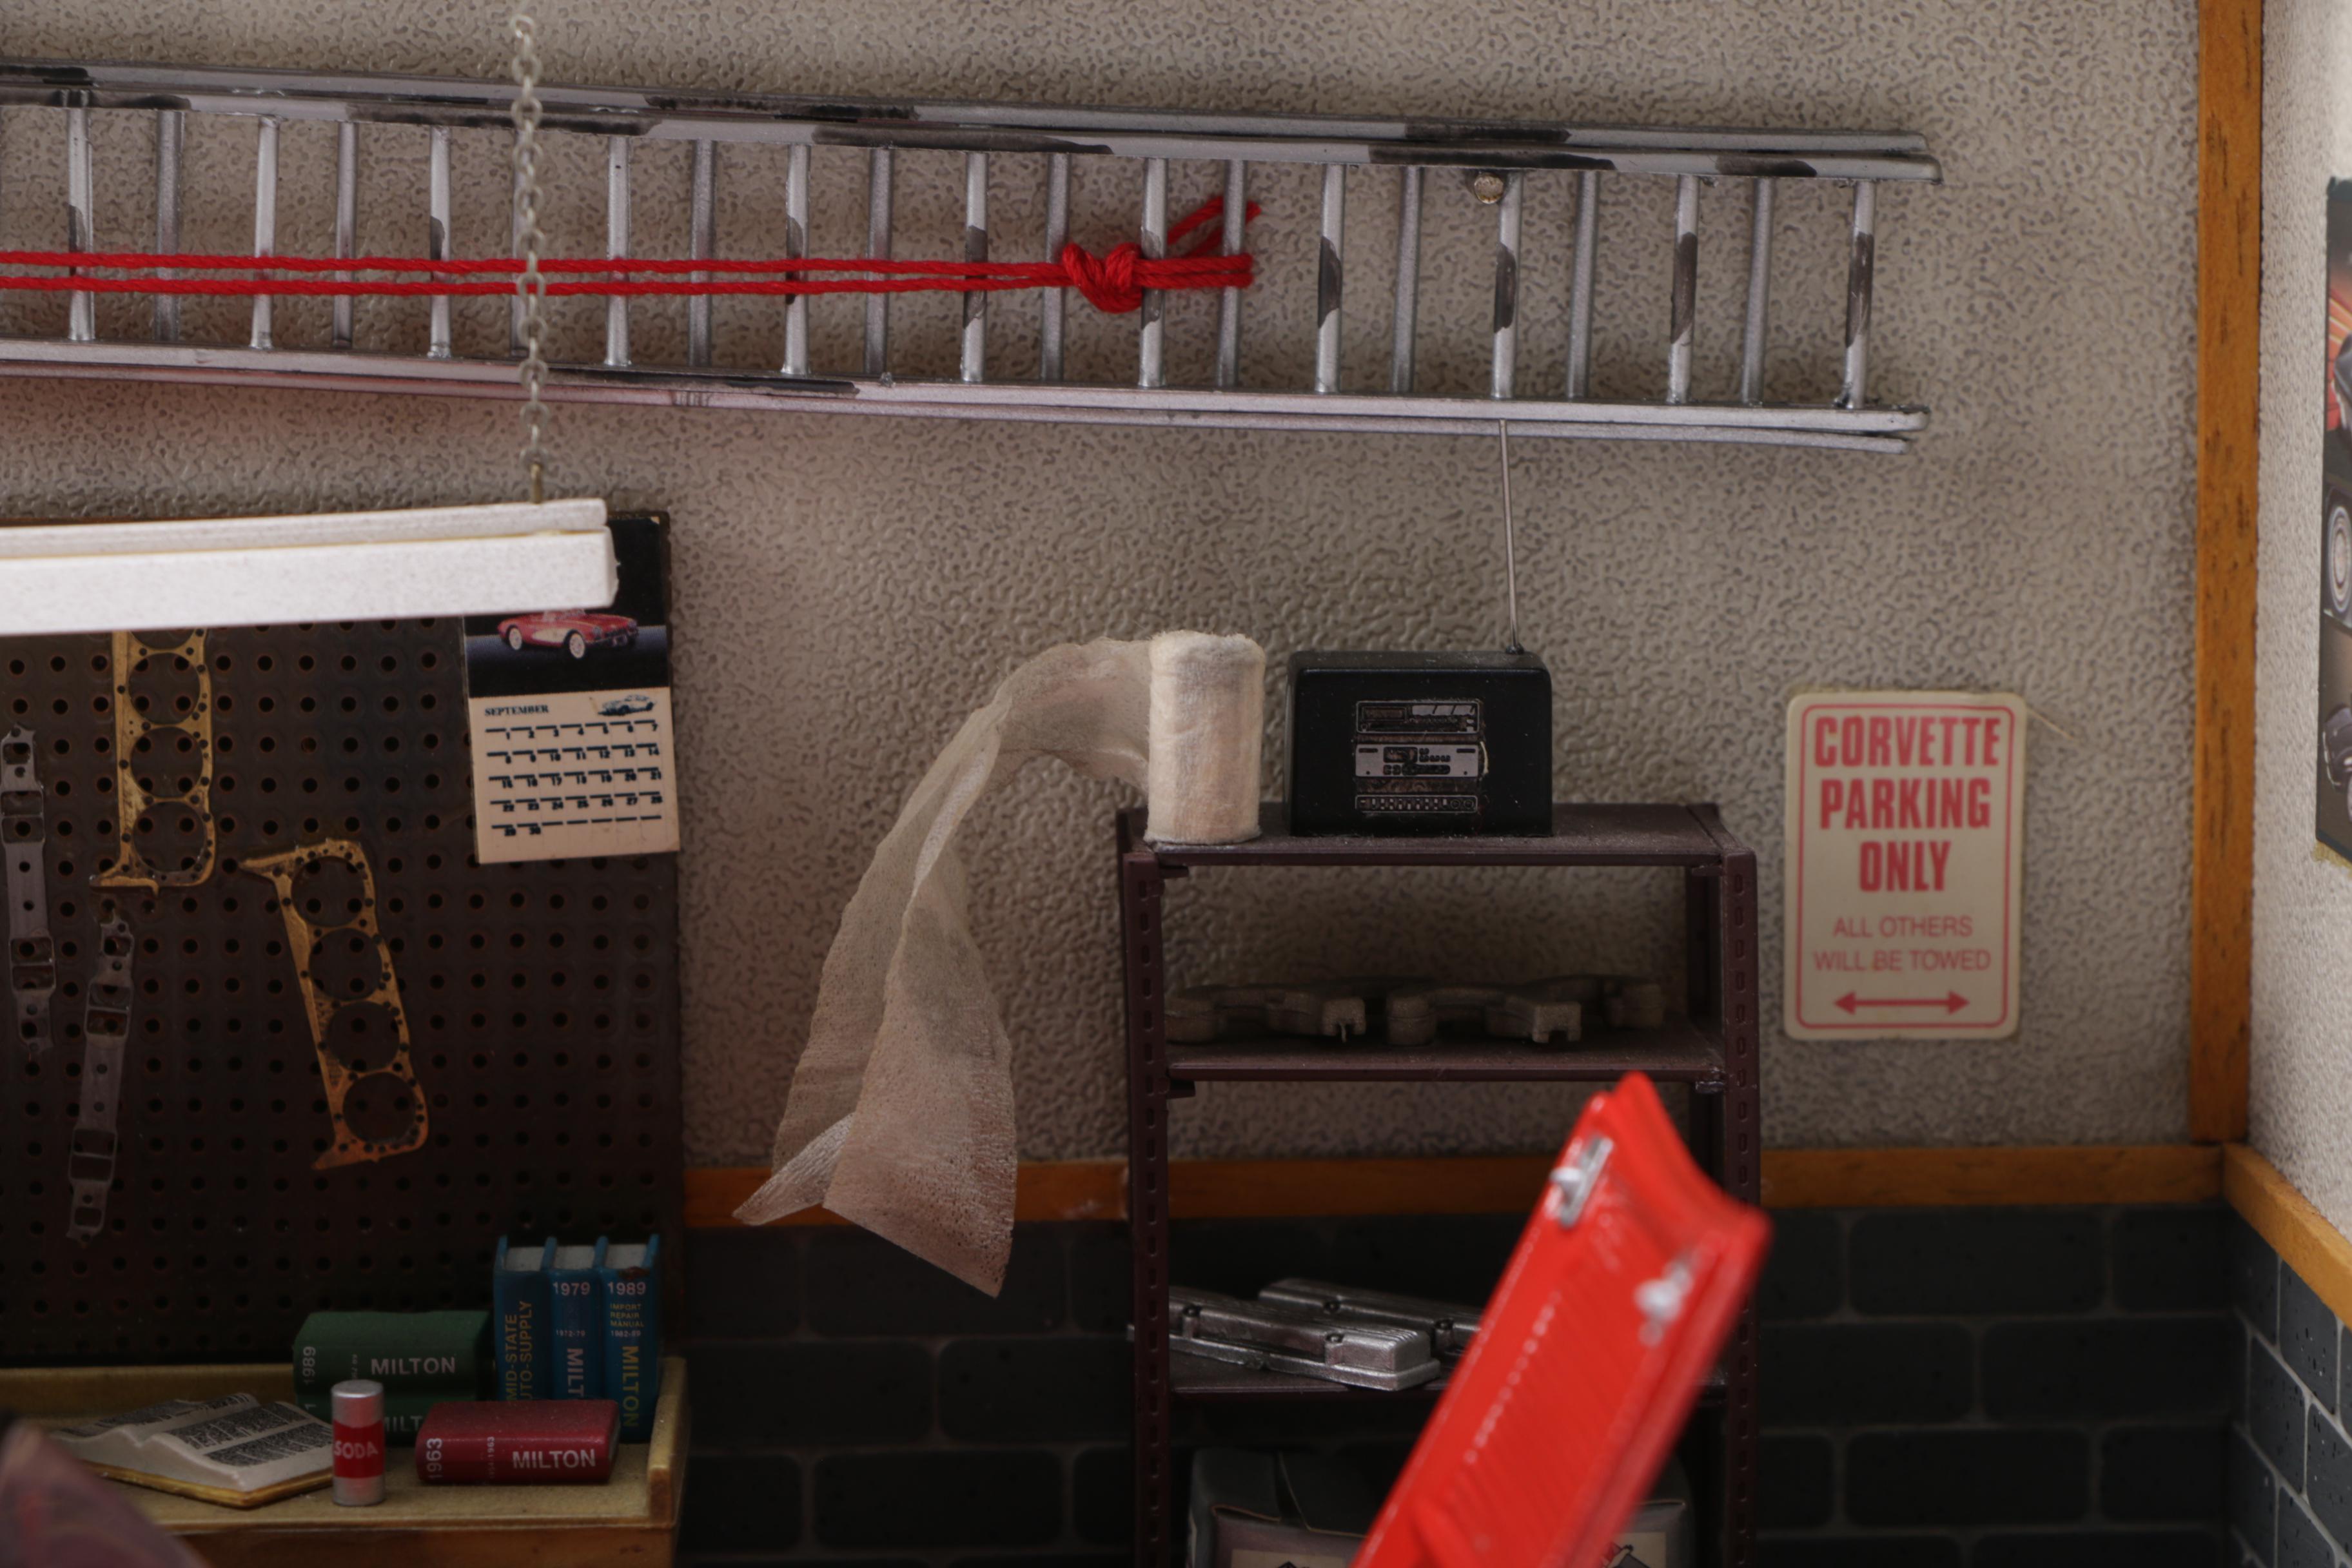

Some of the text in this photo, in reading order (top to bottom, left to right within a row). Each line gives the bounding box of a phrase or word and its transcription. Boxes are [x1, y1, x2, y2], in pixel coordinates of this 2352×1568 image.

[485, 705, 549, 716] SEPTEMBER
[1814, 715, 2002, 767] CORVETTE
[1819, 778, 1992, 830] PARKING
[1859, 841, 1952, 892] ONLY
[1832, 916, 1973, 937] ALL OTHERS
[1813, 950, 1992, 971] WILL BE TOWED
[552, 1281, 591, 1296] 1979
[607, 1282, 647, 1296] 1989
[302, 1346, 317, 1386] 1989
[370, 1357, 456, 1376] MILTON
[621, 1345, 640, 1427] MILTON
[332, 1440, 379, 1460] SODA
[426, 1437, 443, 1481] 1963
[512, 1449, 596, 1469] MILTON
